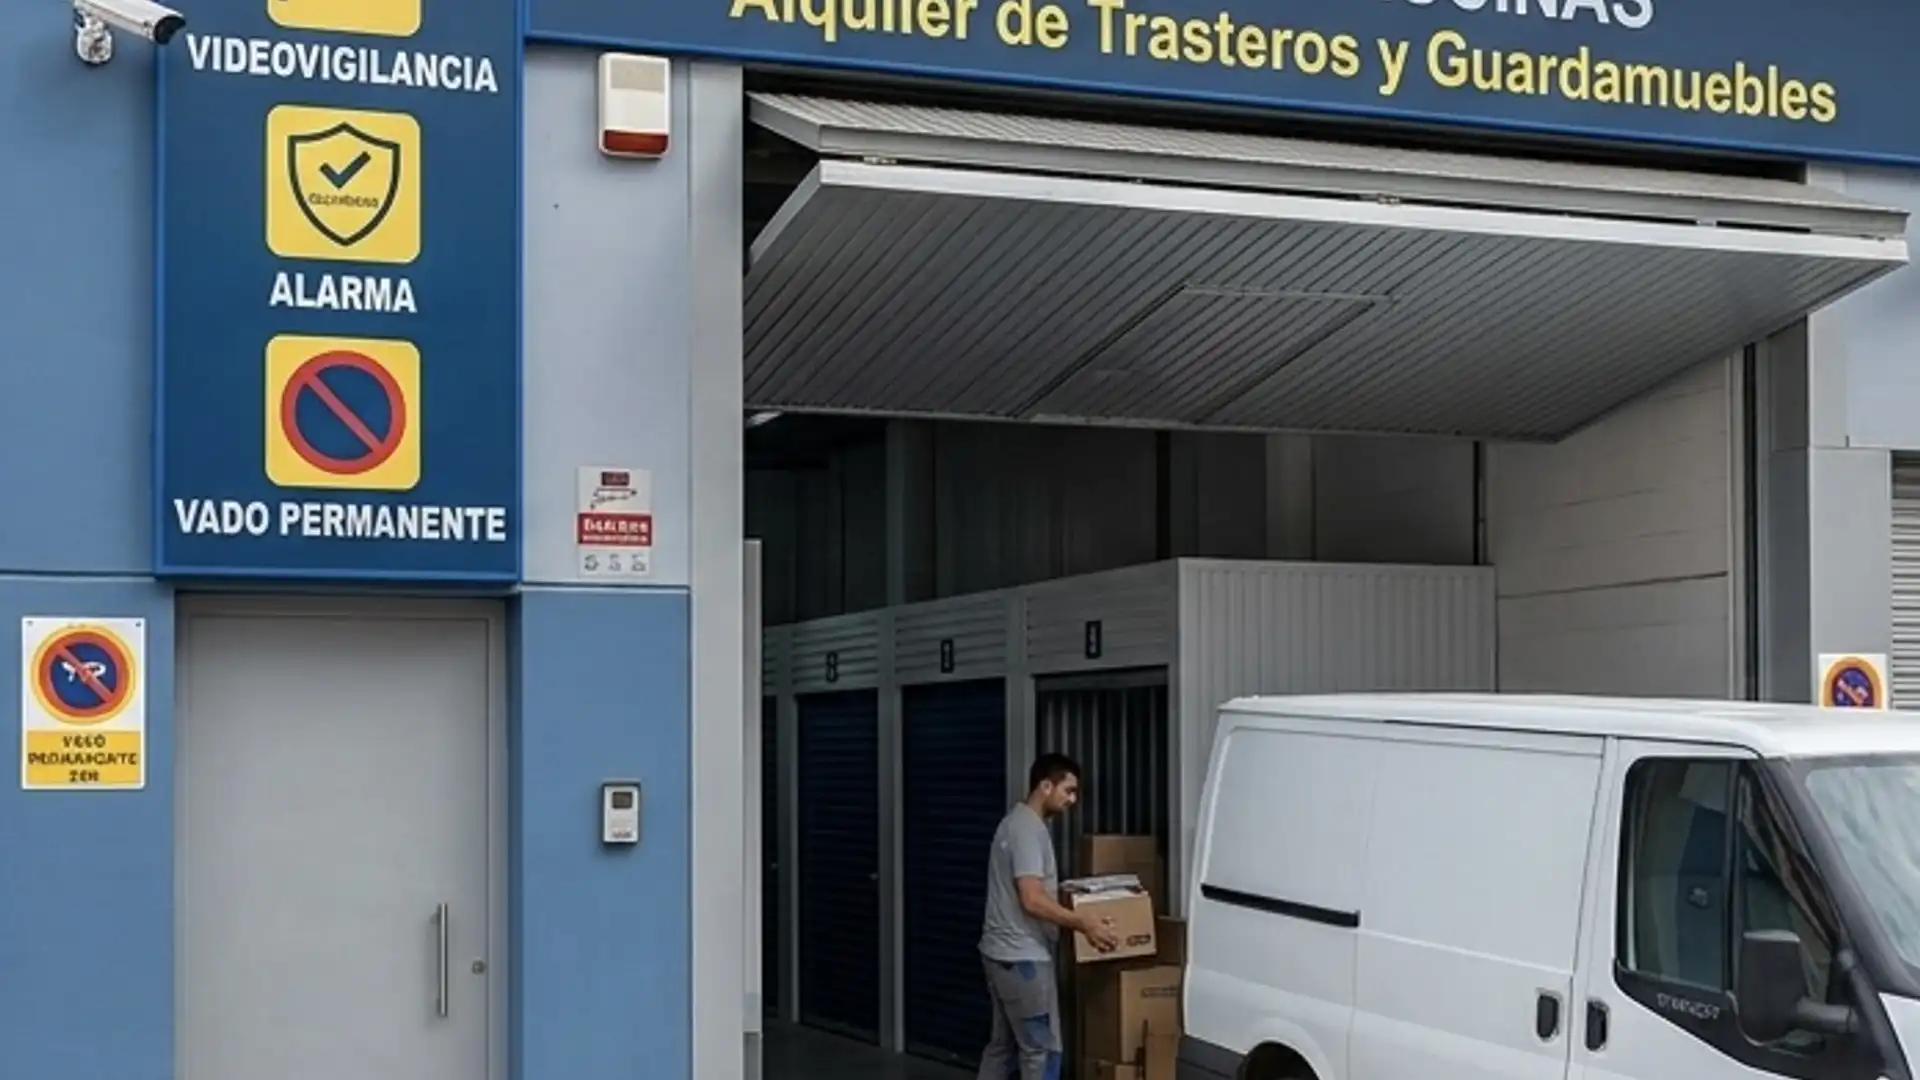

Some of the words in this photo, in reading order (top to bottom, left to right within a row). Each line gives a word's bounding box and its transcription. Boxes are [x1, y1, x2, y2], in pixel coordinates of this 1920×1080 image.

[185, 33, 499, 93] VIDEOVIGILANCIA
[996, 0, 1068, 48] de
[1089, 0, 1360, 76] Trasteros
[1379, 39, 1409, 95] y
[1426, 29, 1839, 122] Guardamuebles
[269, 272, 417, 314] ALARMA
[173, 498, 270, 536] VADO
[279, 502, 507, 542] PERMANENTE
